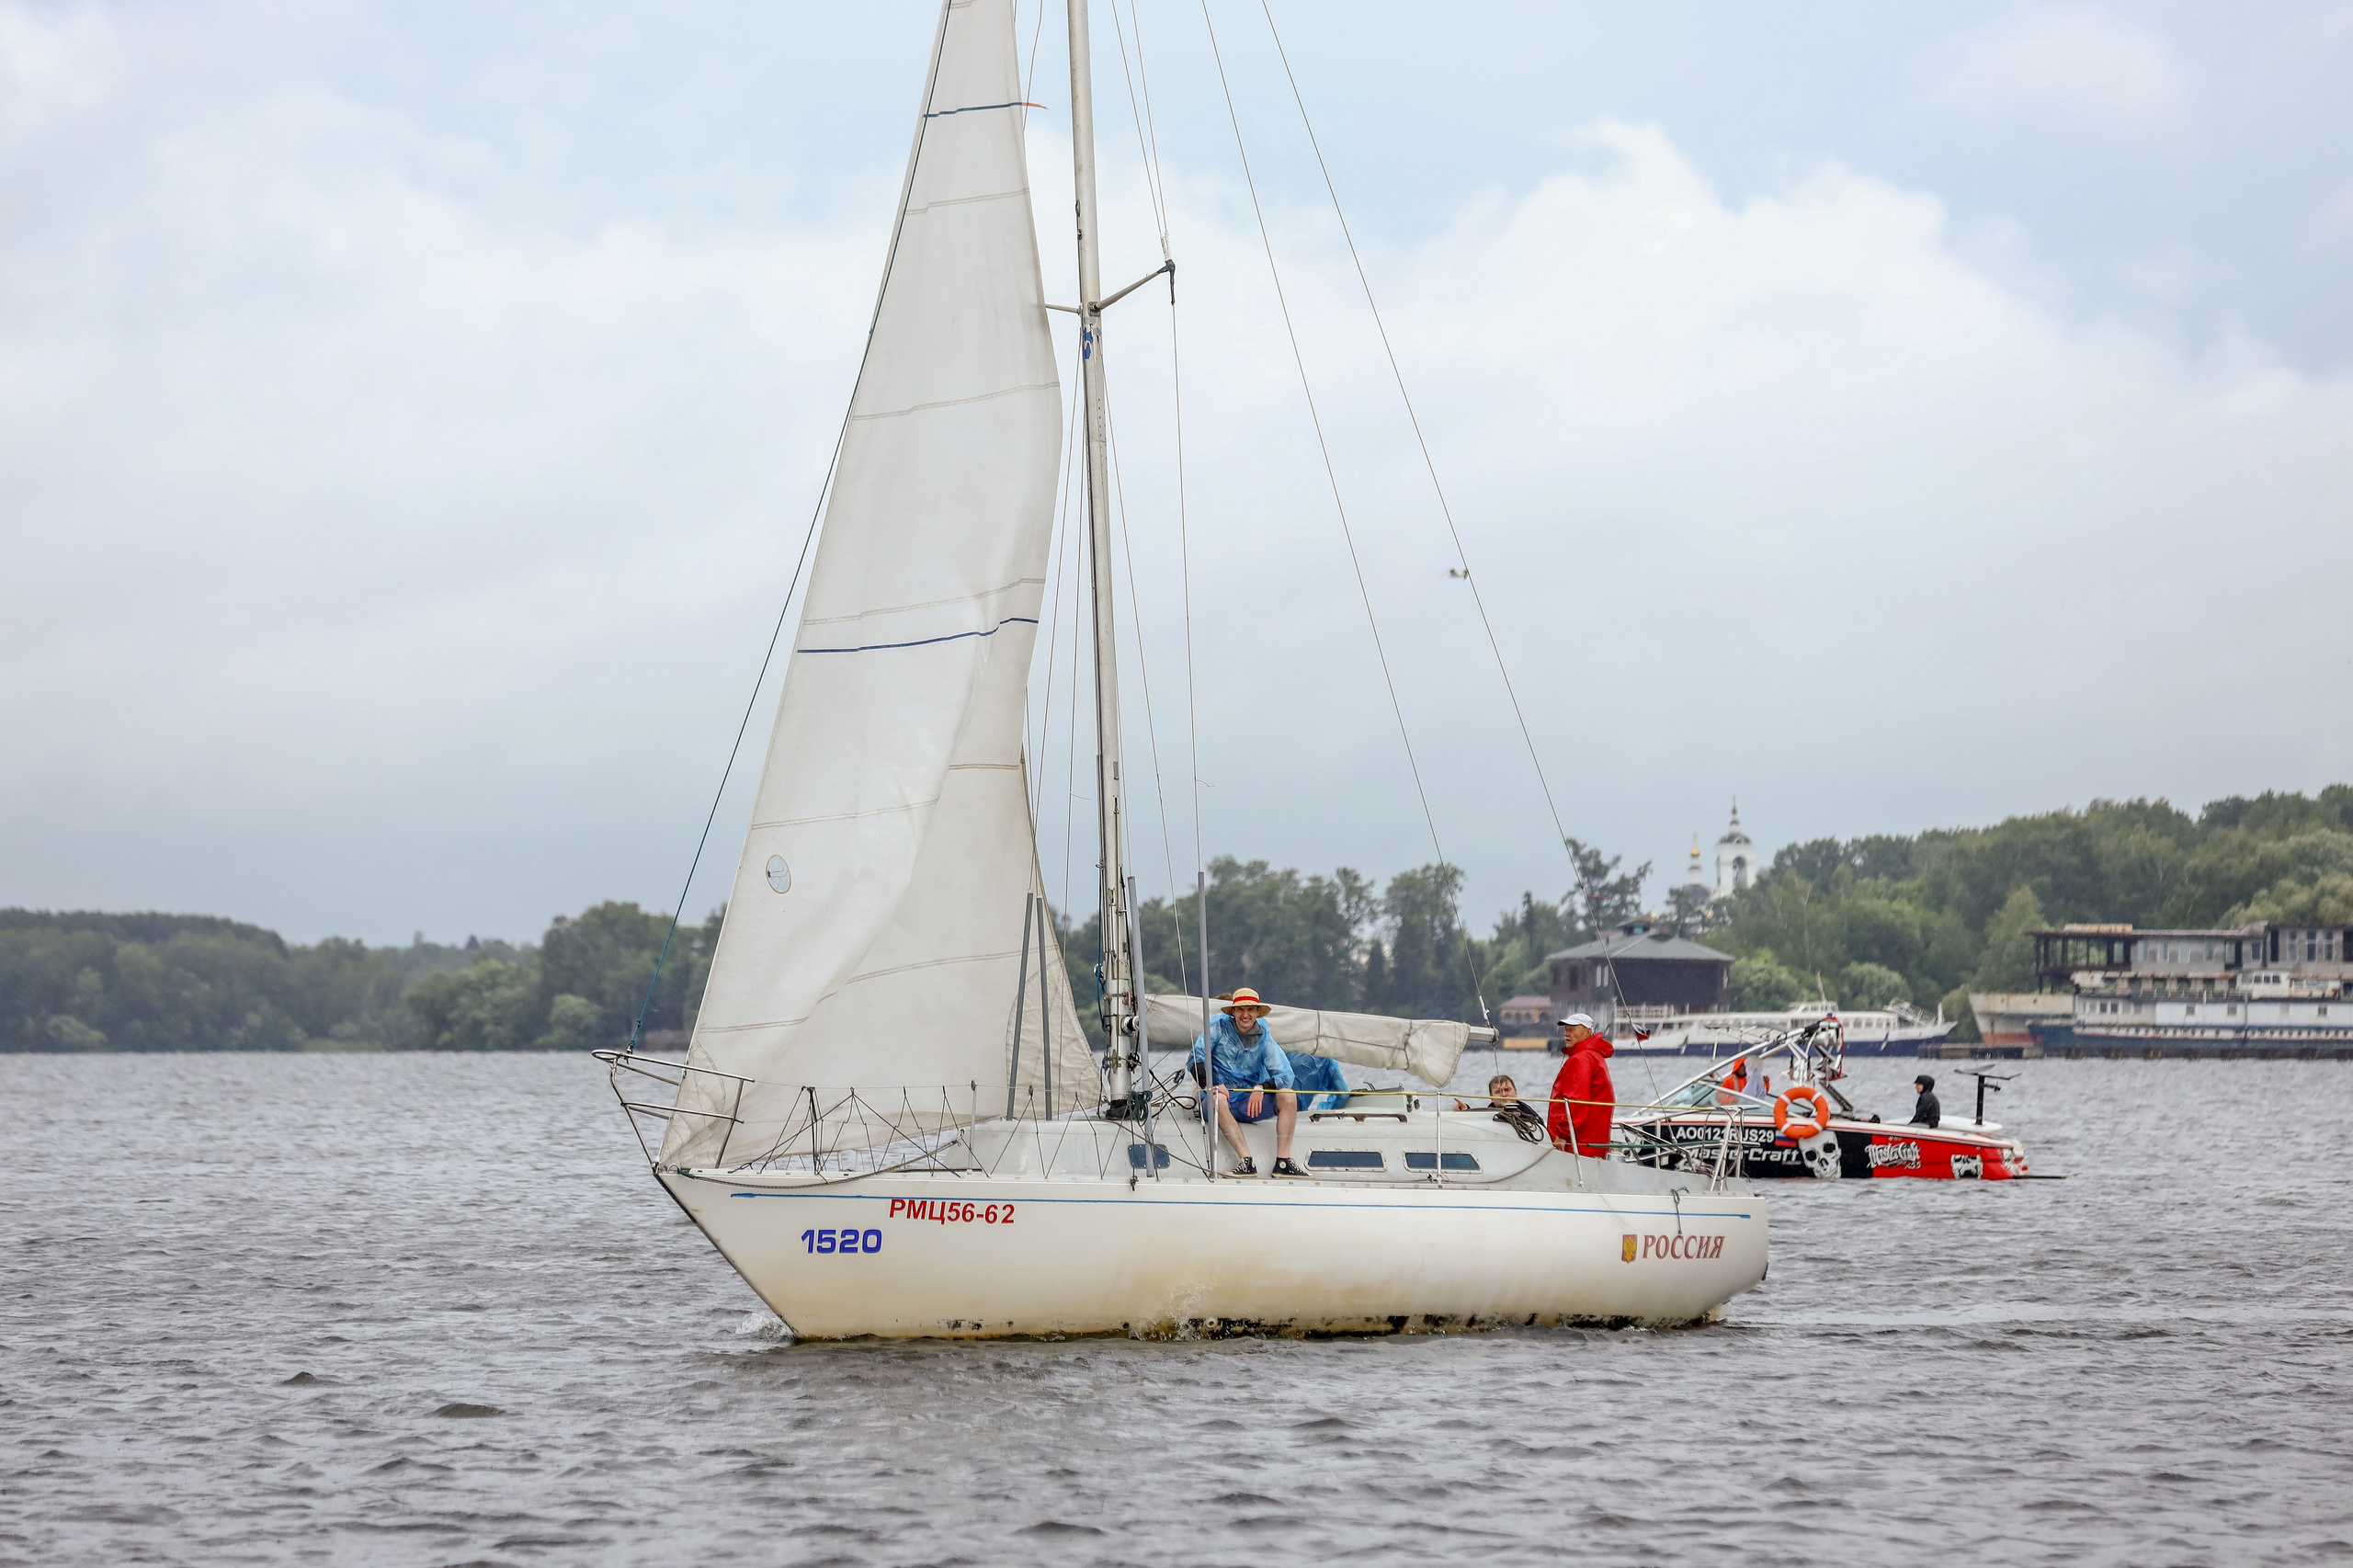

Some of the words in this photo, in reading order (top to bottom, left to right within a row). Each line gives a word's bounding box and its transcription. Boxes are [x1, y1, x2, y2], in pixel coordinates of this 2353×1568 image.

[889, 1199, 1016, 1225] РМЦ56-62
[801, 1229, 883, 1254] 1520
[1642, 1234, 1726, 1260] РОССИЯ
